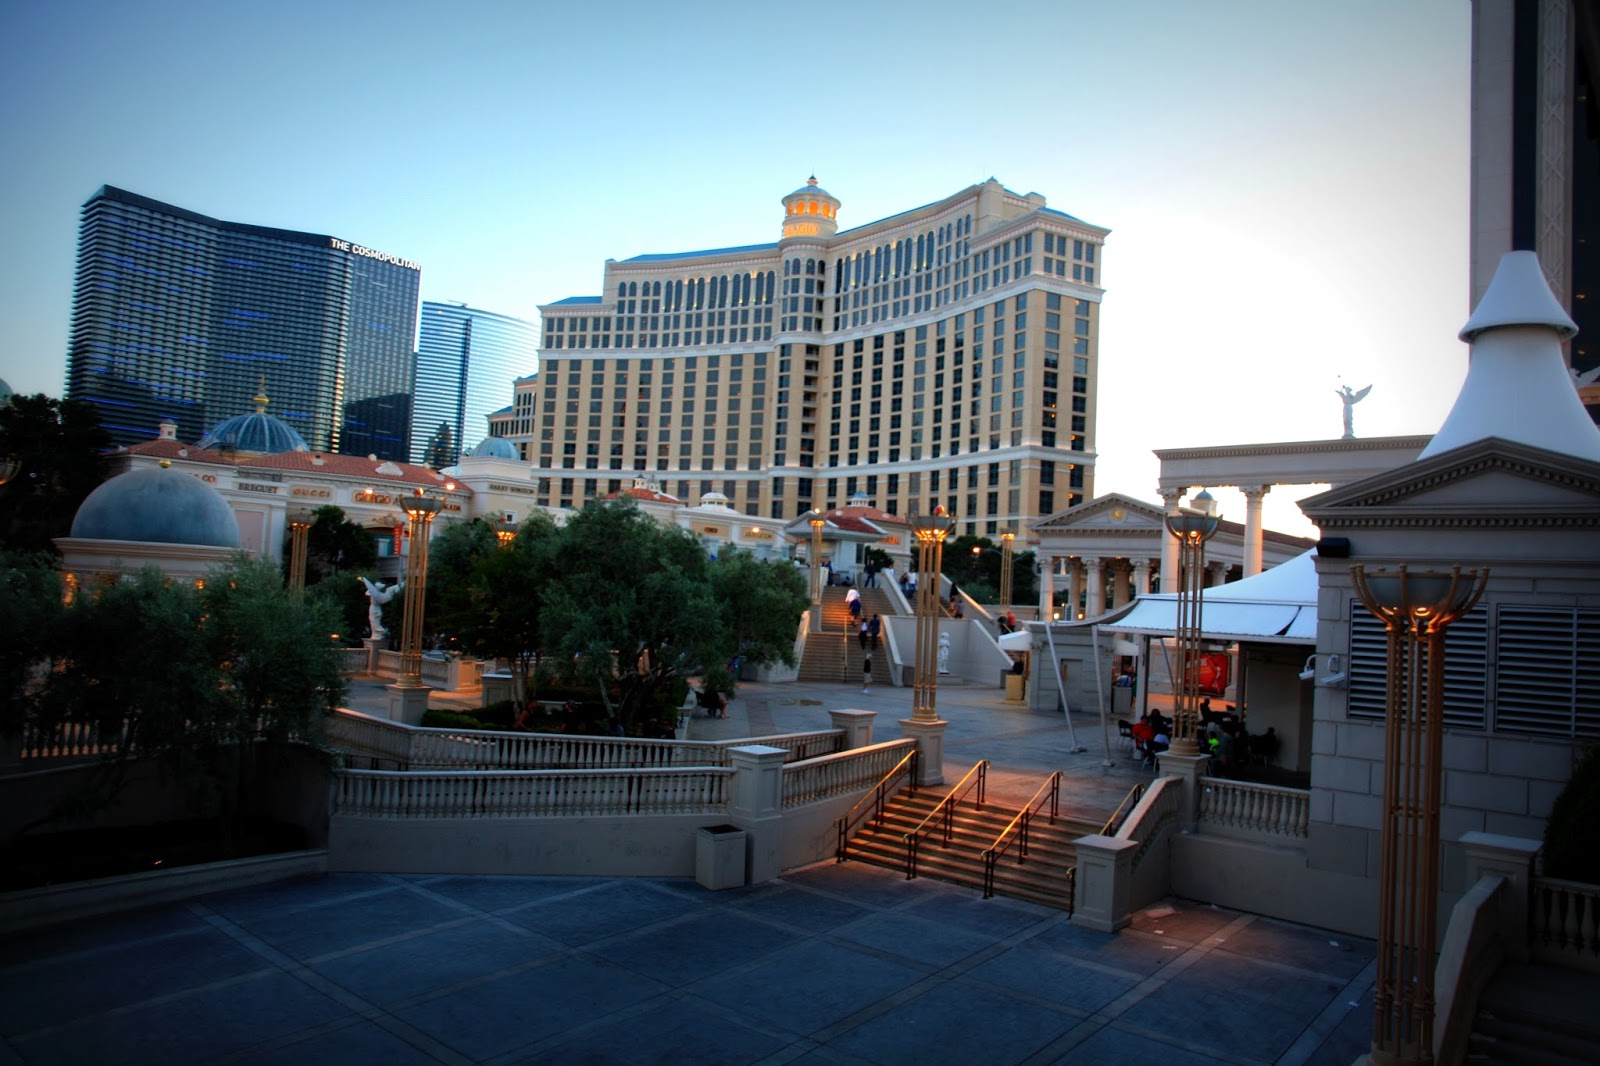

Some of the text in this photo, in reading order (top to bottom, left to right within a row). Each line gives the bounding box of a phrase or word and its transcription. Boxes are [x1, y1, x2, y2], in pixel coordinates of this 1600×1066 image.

[331, 238, 420, 270] THE COSMOPOLITAN
[238, 482, 278, 494] BREGUET
[293, 488, 330, 498] GUCCI
[354, 492, 392, 505] GIORGIO
